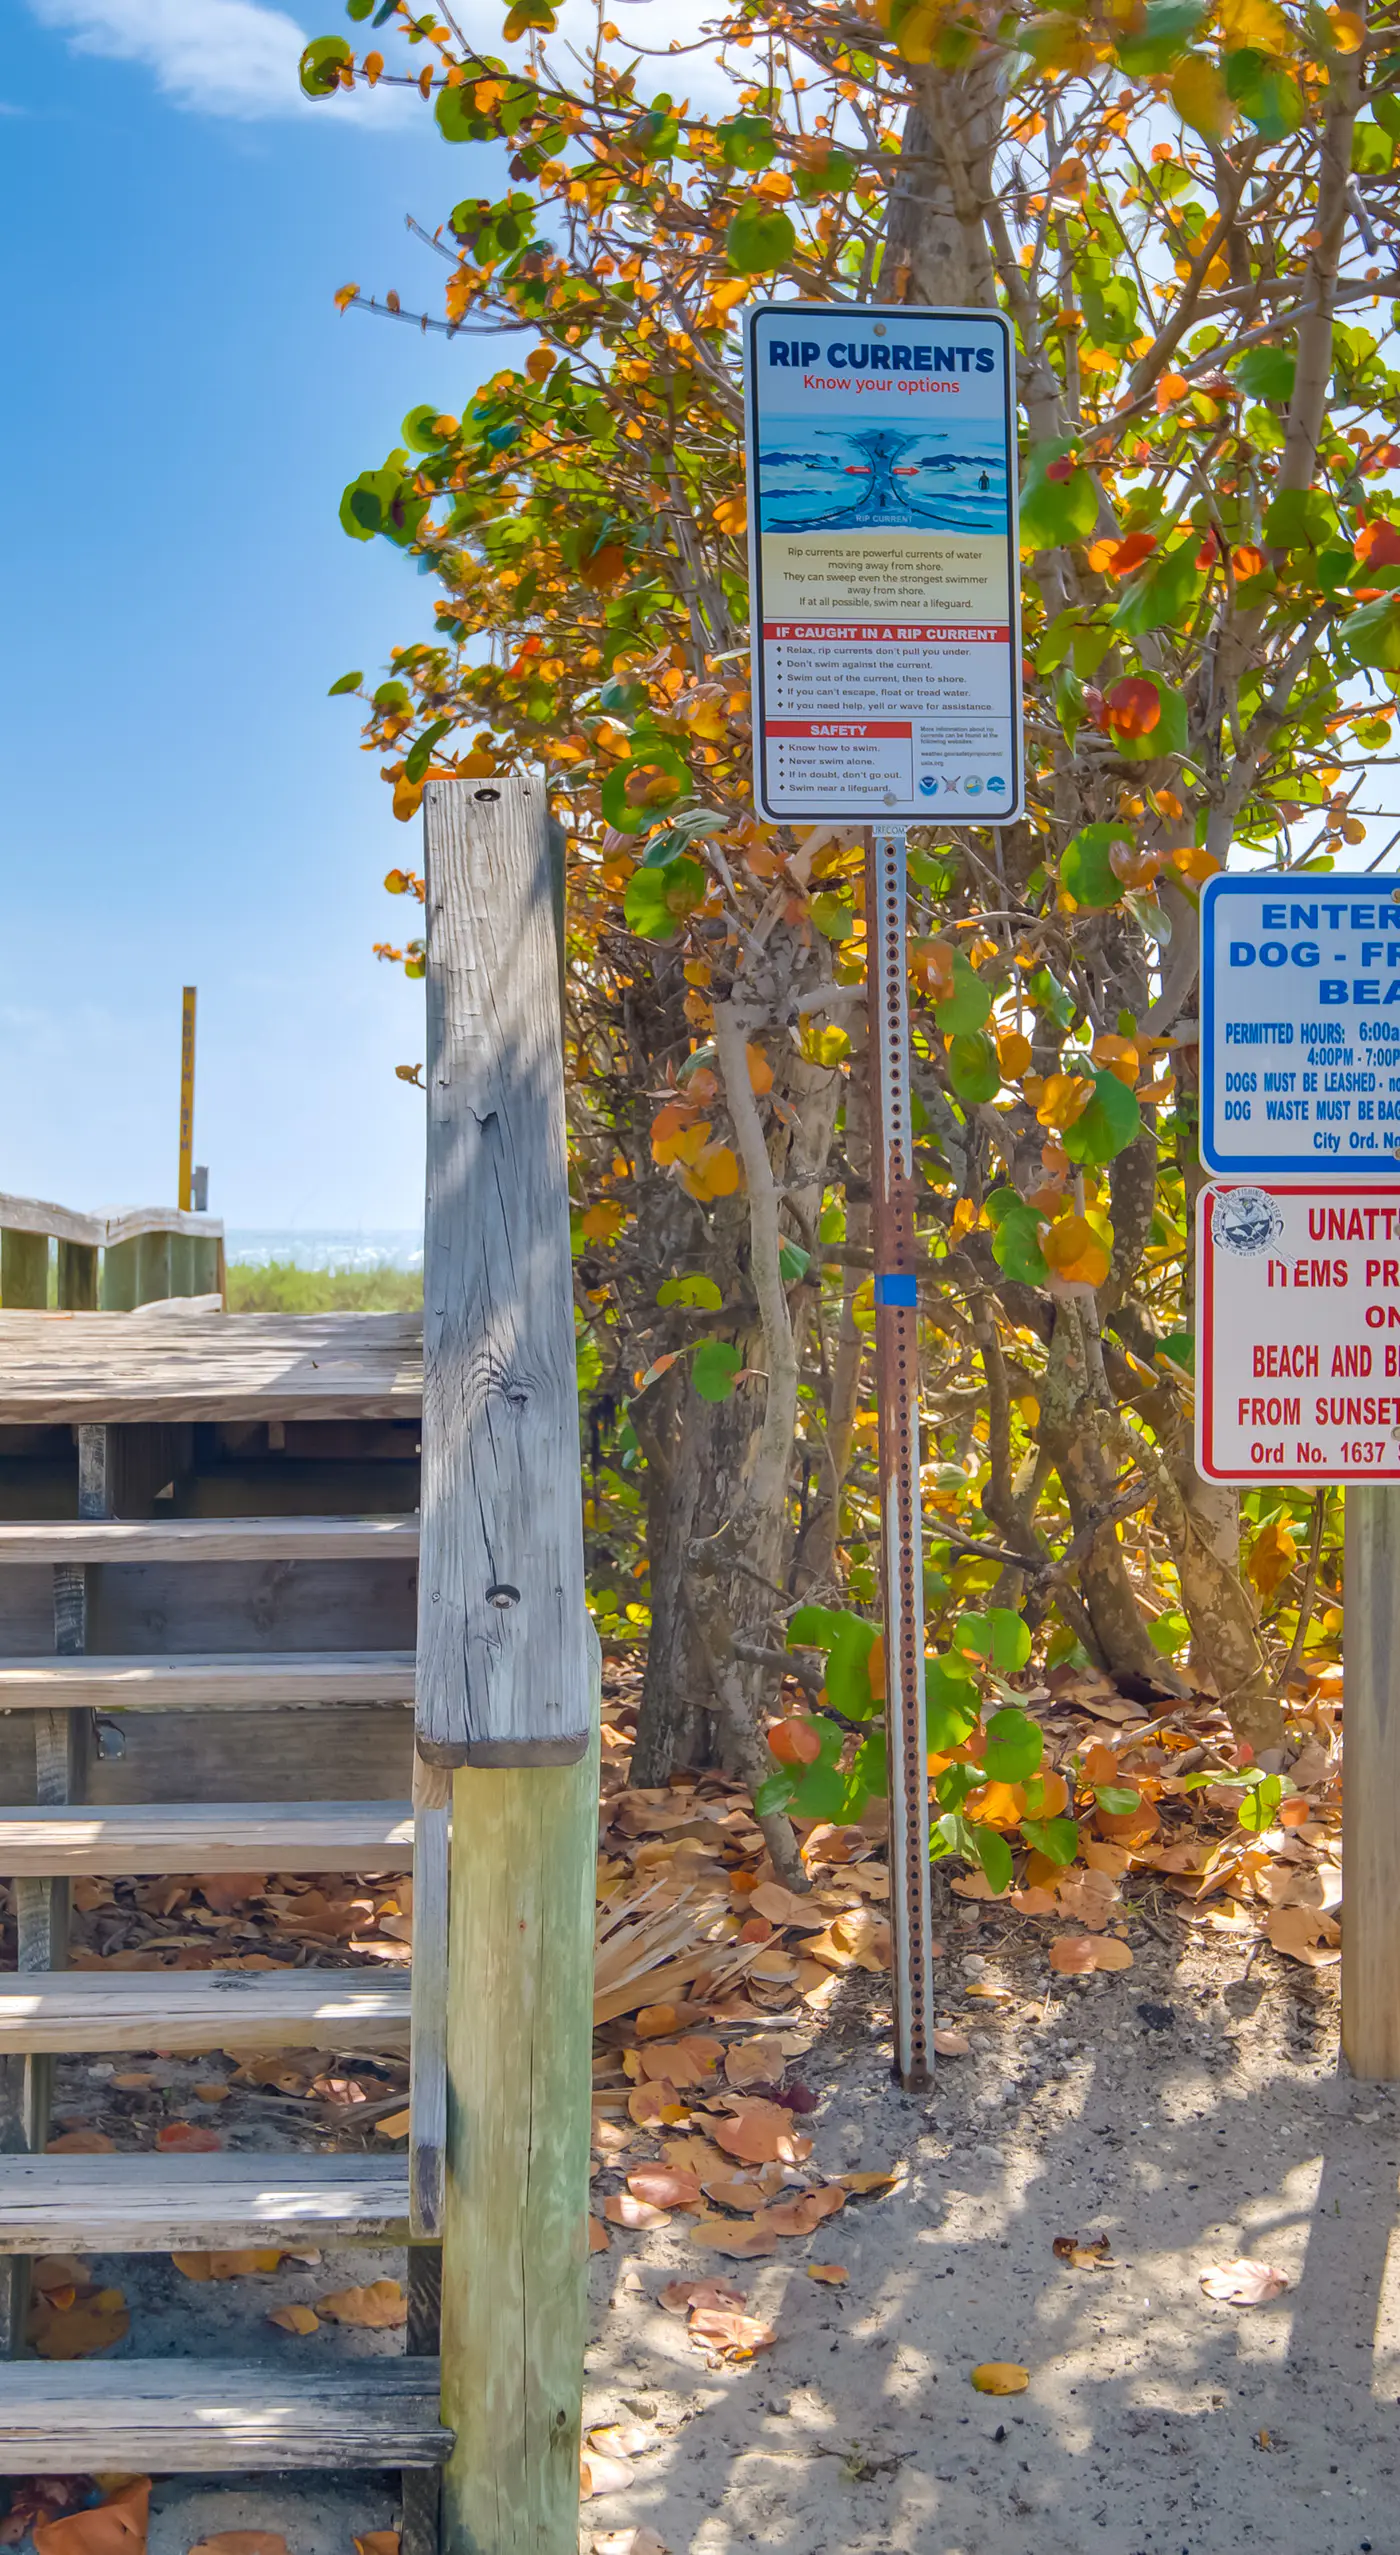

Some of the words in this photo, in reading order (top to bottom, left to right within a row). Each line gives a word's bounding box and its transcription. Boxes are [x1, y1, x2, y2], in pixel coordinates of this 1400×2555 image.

[769, 340, 821, 367] RIP
[827, 343, 995, 373] CURRENTS
[803, 374, 851, 390] Know
[855, 378, 894, 394] your
[897, 377, 960, 395] options
[855, 515, 871, 523] RIP
[872, 515, 912, 523] CURRENT
[788, 547, 803, 558] Rip
[805, 548, 844, 557] currents
[846, 550, 861, 558] are
[862, 549, 904, 560] powerful
[905, 551, 944, 559] currents
[945, 550, 955, 559] of
[956, 551, 982, 560] water
[828, 561, 863, 572] moving
[865, 563, 889, 573] away
[891, 562, 914, 571] from
[915, 562, 944, 571] shore.
[783, 572, 805, 582] They
[807, 573, 824, 582] can
[826, 574, 856, 584] sweep
[858, 575, 880, 583] even
[882, 574, 898, 583] the
[899, 575, 943, 586] strongest
[945, 575, 988, 584] swimmer
[847, 587, 871, 596] away
[873, 586, 896, 595] from
[897, 586, 926, 596] shore.
[799, 597, 806, 607] If
[807, 598, 817, 607] at
[819, 598, 830, 607] all
[832, 598, 872, 609] possible,
[874, 599, 898, 608] swim
[900, 600, 921, 608] near
[922, 600, 929, 608] a
[930, 599, 973, 610] lifeguard.
[776, 627, 790, 638] IF
[794, 627, 858, 638] CAUGHT
[862, 628, 878, 639] IN
[882, 628, 894, 639] A
[897, 628, 922, 639] RIP
[926, 629, 998, 640] CURRENT
[786, 646, 816, 656] Relax,
[817, 646, 832, 657] rip
[833, 647, 873, 656] currents
[875, 647, 900, 656] don't
[902, 647, 920, 657] pull
[922, 649, 940, 658] you
[942, 648, 971, 657] under.
[786, 660, 813, 669] Don't
[814, 660, 840, 669] swim
[842, 660, 877, 671] against
[879, 661, 894, 669] the
[896, 661, 933, 670] current.
[787, 674, 814, 683] Swim
[815, 674, 832, 683] out
[834, 674, 844, 683] of
[845, 674, 861, 683] the
[863, 675, 900, 684] current,
[902, 675, 924, 684] then
[925, 675, 936, 684] to
[937, 675, 967, 684] shore.
[787, 687, 794, 696] If
[796, 689, 814, 698] you
[816, 688, 841, 697] can't
[842, 689, 879, 699] escape,
[881, 688, 902, 697] float
[916, 688, 941, 697] tread
[943, 689, 971, 698] water.
[787, 701, 794, 710] If
[796, 703, 814, 712] you
[816, 702, 840, 711] need
[842, 702, 866, 712] help,
[868, 702, 885, 712] yell
[887, 703, 898, 711] or
[899, 703, 924, 711] wave
[926, 702, 940, 711] for
[941, 702, 995, 712] assistance.
[810, 725, 868, 736] SAFETY
[788, 744, 816, 752] Know
[818, 744, 839, 752] how
[841, 744, 851, 752] to
[852, 744, 880, 752] swim.
[789, 757, 816, 765] Never
[846, 758, 875, 766] alone.
[809, 771, 840, 780] doubt,
[842, 771, 867, 779] don't
[789, 784, 815, 792] Swim
[848, 785, 892, 793] lifeguard.
[1229, 941, 1320, 968] DOG
[1225, 1023, 1294, 1044] PERMITTED
[1300, 1023, 1345, 1044] HOURS:
[1307, 1048, 1354, 1066] 4:00PM
[1225, 1072, 1257, 1092] DOGS
[1264, 1072, 1297, 1092] MUST
[1303, 1072, 1318, 1092] BE
[1324, 1072, 1376, 1092] LEASHED
[1224, 1100, 1251, 1121] DOG
[1266, 1100, 1309, 1121] WASTE
[1316, 1100, 1351, 1121] MUST
[1358, 1100, 1374, 1121] BE
[1313, 1132, 1341, 1153] City
[1349, 1131, 1379, 1149] Ord.
[1237, 1188, 1264, 1197] FISHING
[1264, 1194, 1282, 1218] CENTER
[1308, 1208, 1400, 1240] UNATT
[1268, 1259, 1348, 1288] ITEMS
[1253, 1344, 1319, 1378] BEACH
[1331, 1344, 1373, 1378] AND
[1385, 1345, 1400, 1377] B
[1238, 1397, 1301, 1426] FROM
[1315, 1397, 1400, 1425] SUNSET
[1250, 1442, 1284, 1464] Ord
[1297, 1442, 1327, 1464] No.
[1340, 1442, 1386, 1463] 1637
